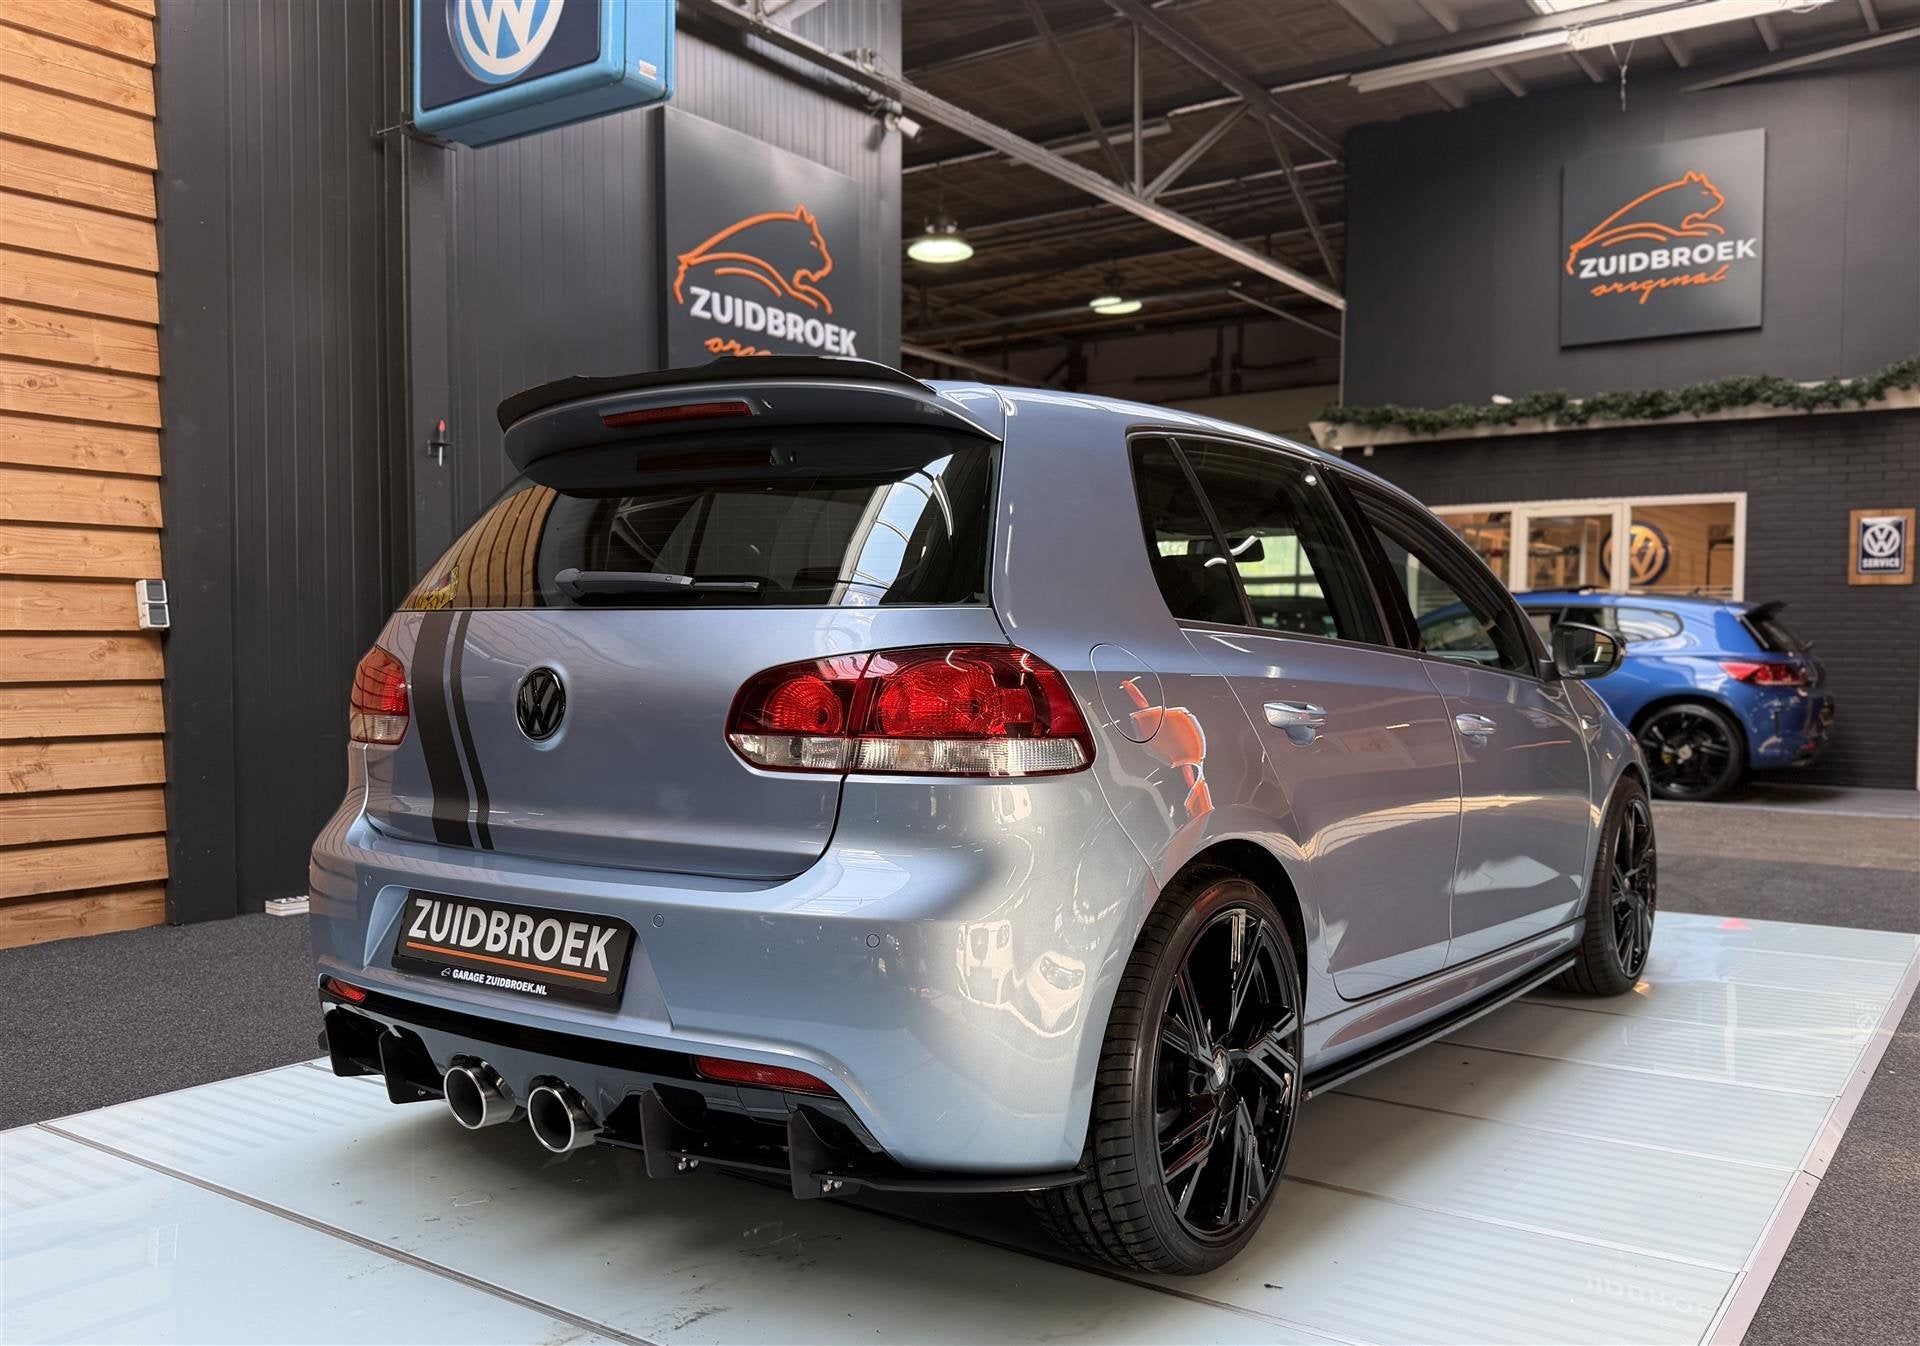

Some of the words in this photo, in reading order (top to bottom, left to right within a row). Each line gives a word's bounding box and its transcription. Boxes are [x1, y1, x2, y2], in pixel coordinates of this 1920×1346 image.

[1578, 238, 1758, 279] ZUIDBROEK
[689, 286, 858, 357] ZUIDBROEK
[408, 898, 618, 972] ZUIDBROEK
[452, 968, 485, 984] GARAGE
[485, 975, 548, 996] ZUIDBROEK.NL
